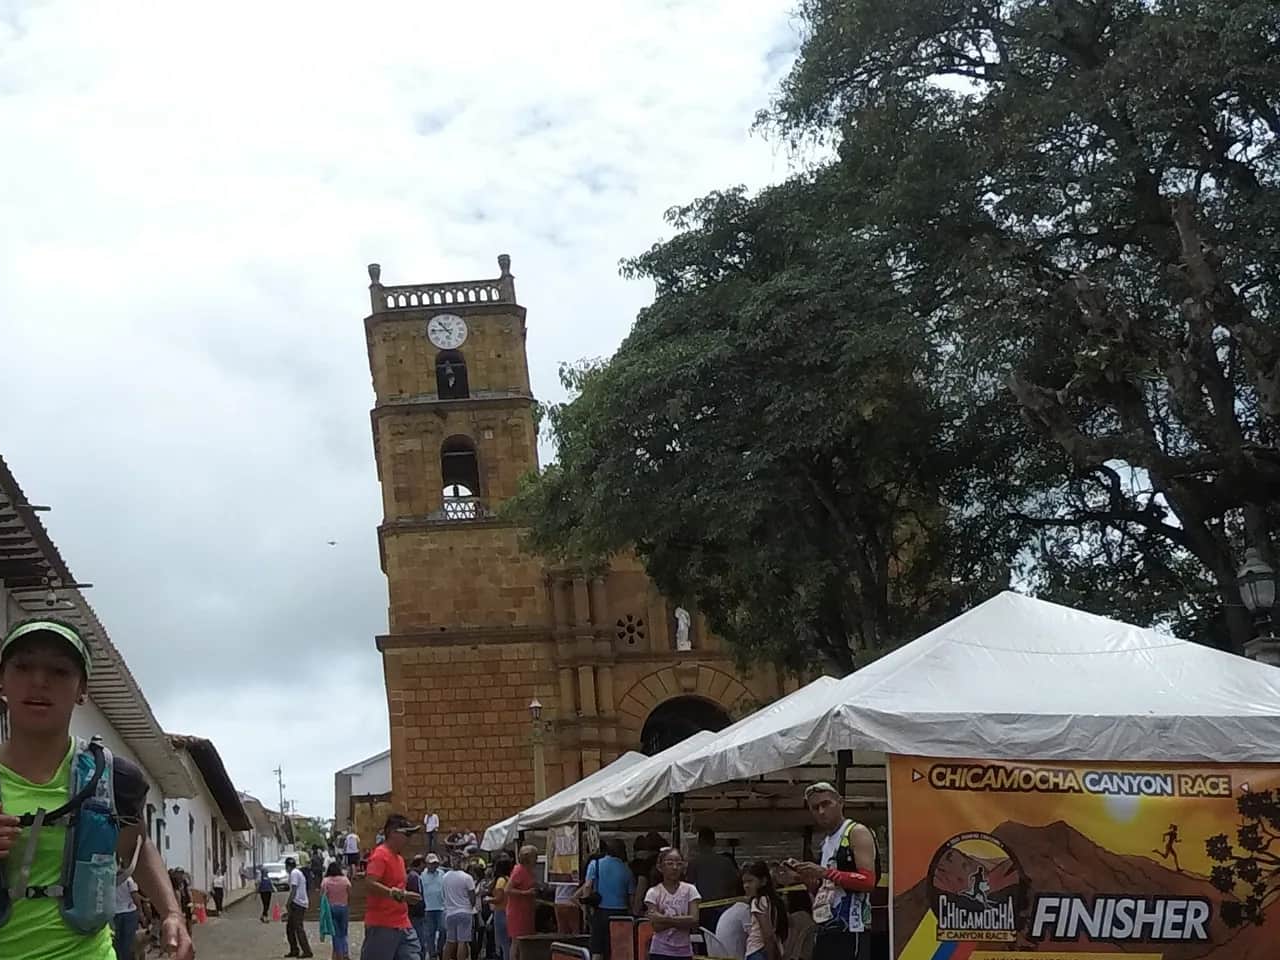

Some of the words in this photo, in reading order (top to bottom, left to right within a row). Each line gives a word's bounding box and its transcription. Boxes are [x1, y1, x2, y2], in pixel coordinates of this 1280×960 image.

[930, 766, 1080, 790] CHICAMOCHA
[1084, 772, 1172, 795] CANYON
[1180, 776, 1230, 795] RACE
[939, 894, 1015, 929] CHICAMOCHA
[1031, 897, 1210, 940] FINISHER
[946, 931, 984, 940] CANYON
[986, 931, 1009, 940] RACE
